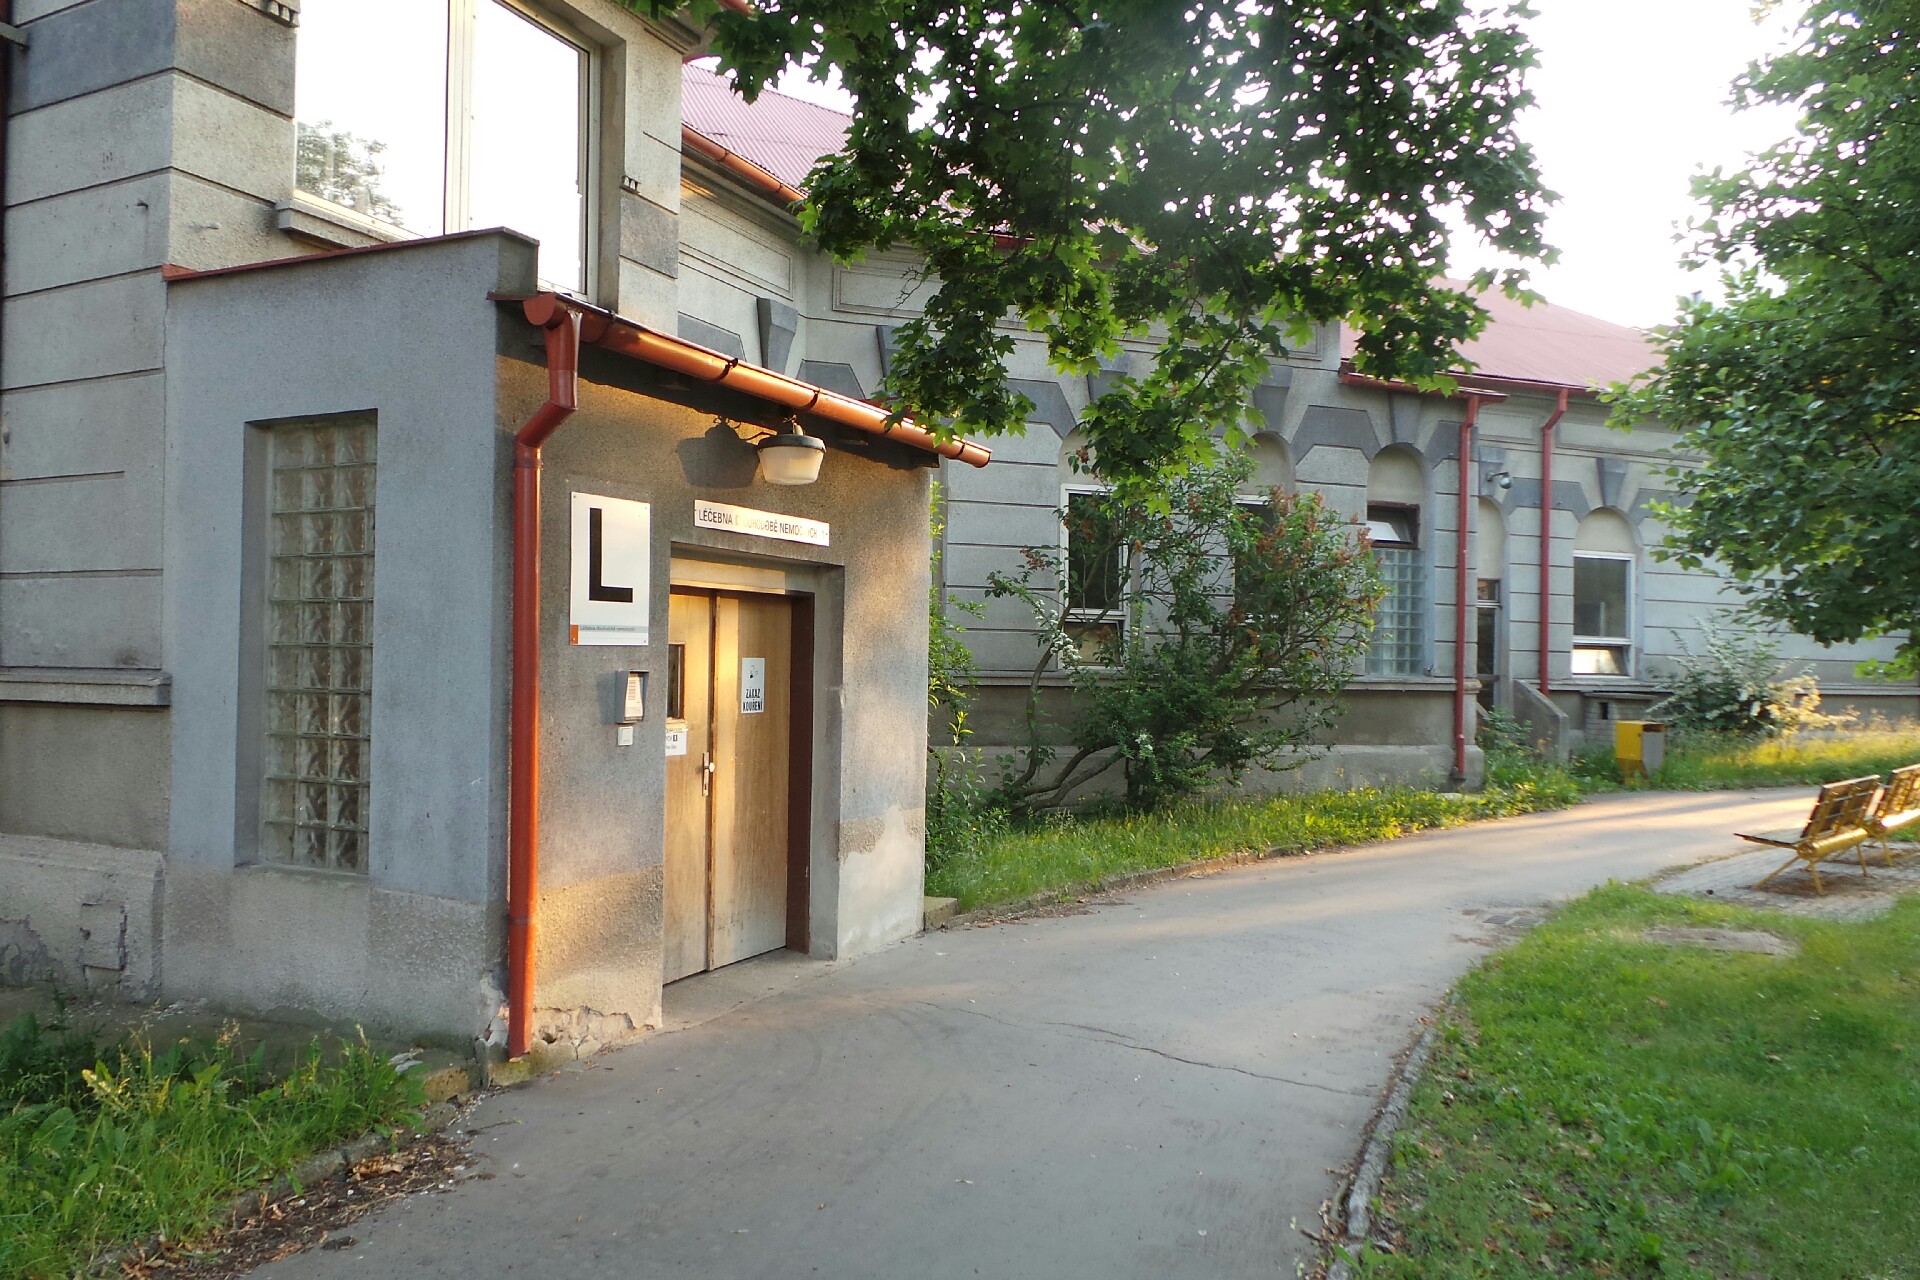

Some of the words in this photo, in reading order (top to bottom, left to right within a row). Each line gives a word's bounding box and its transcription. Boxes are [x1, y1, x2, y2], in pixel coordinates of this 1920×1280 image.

[699, 508, 733, 525] LÉČEBNA
[589, 508, 633, 603] L
[746, 686, 760, 698] ZÁKAZ
[743, 699, 762, 711] KOUŘENÍ
